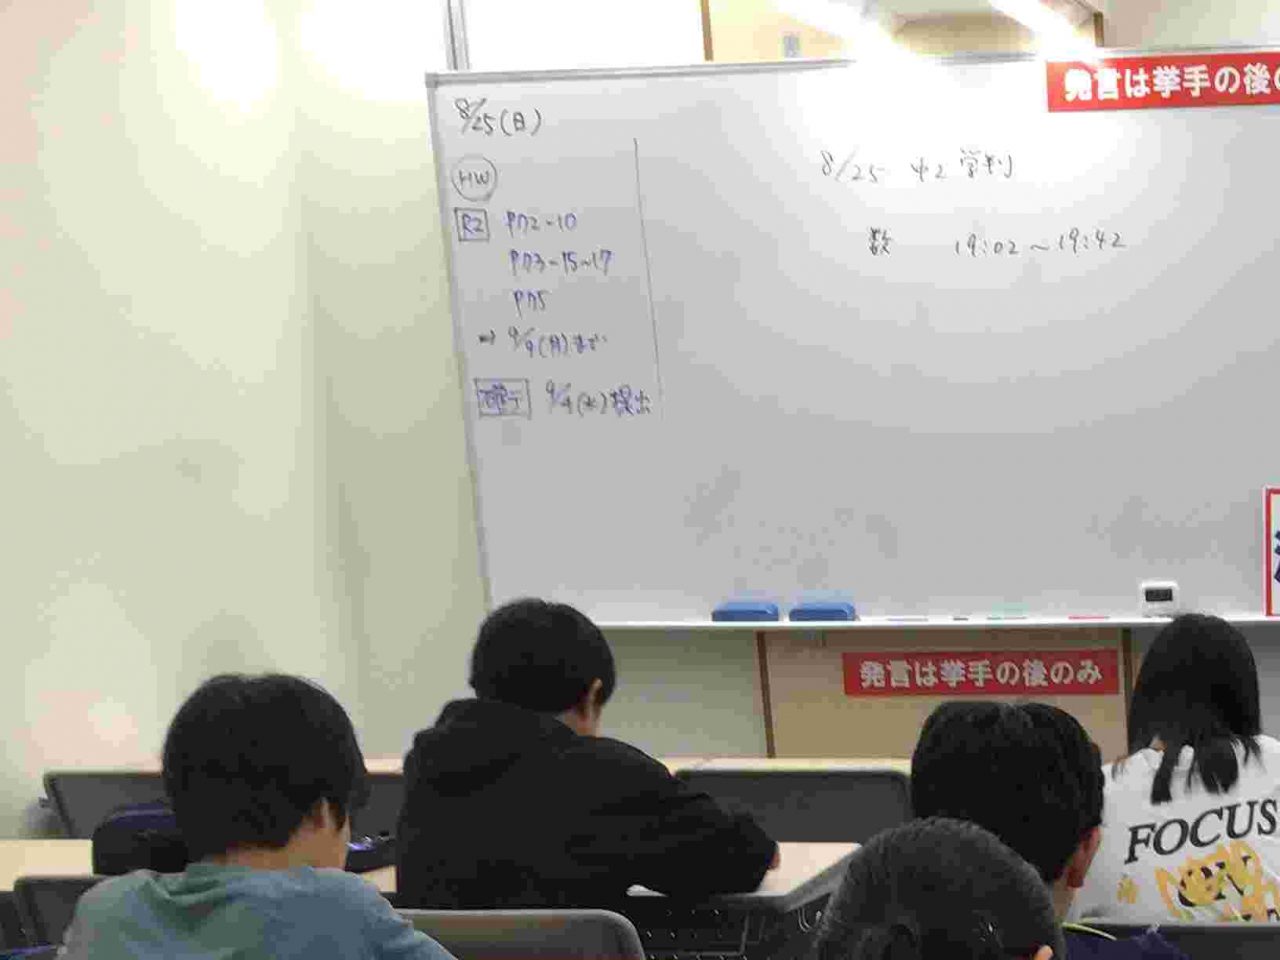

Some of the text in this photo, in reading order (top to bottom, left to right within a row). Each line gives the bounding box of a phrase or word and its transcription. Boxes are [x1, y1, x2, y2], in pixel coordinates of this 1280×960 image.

[459, 169, 490, 189] HW
[859, 658, 1104, 690] 発言は挙手の後のみ
[1123, 798, 1279, 865] FOCUS
